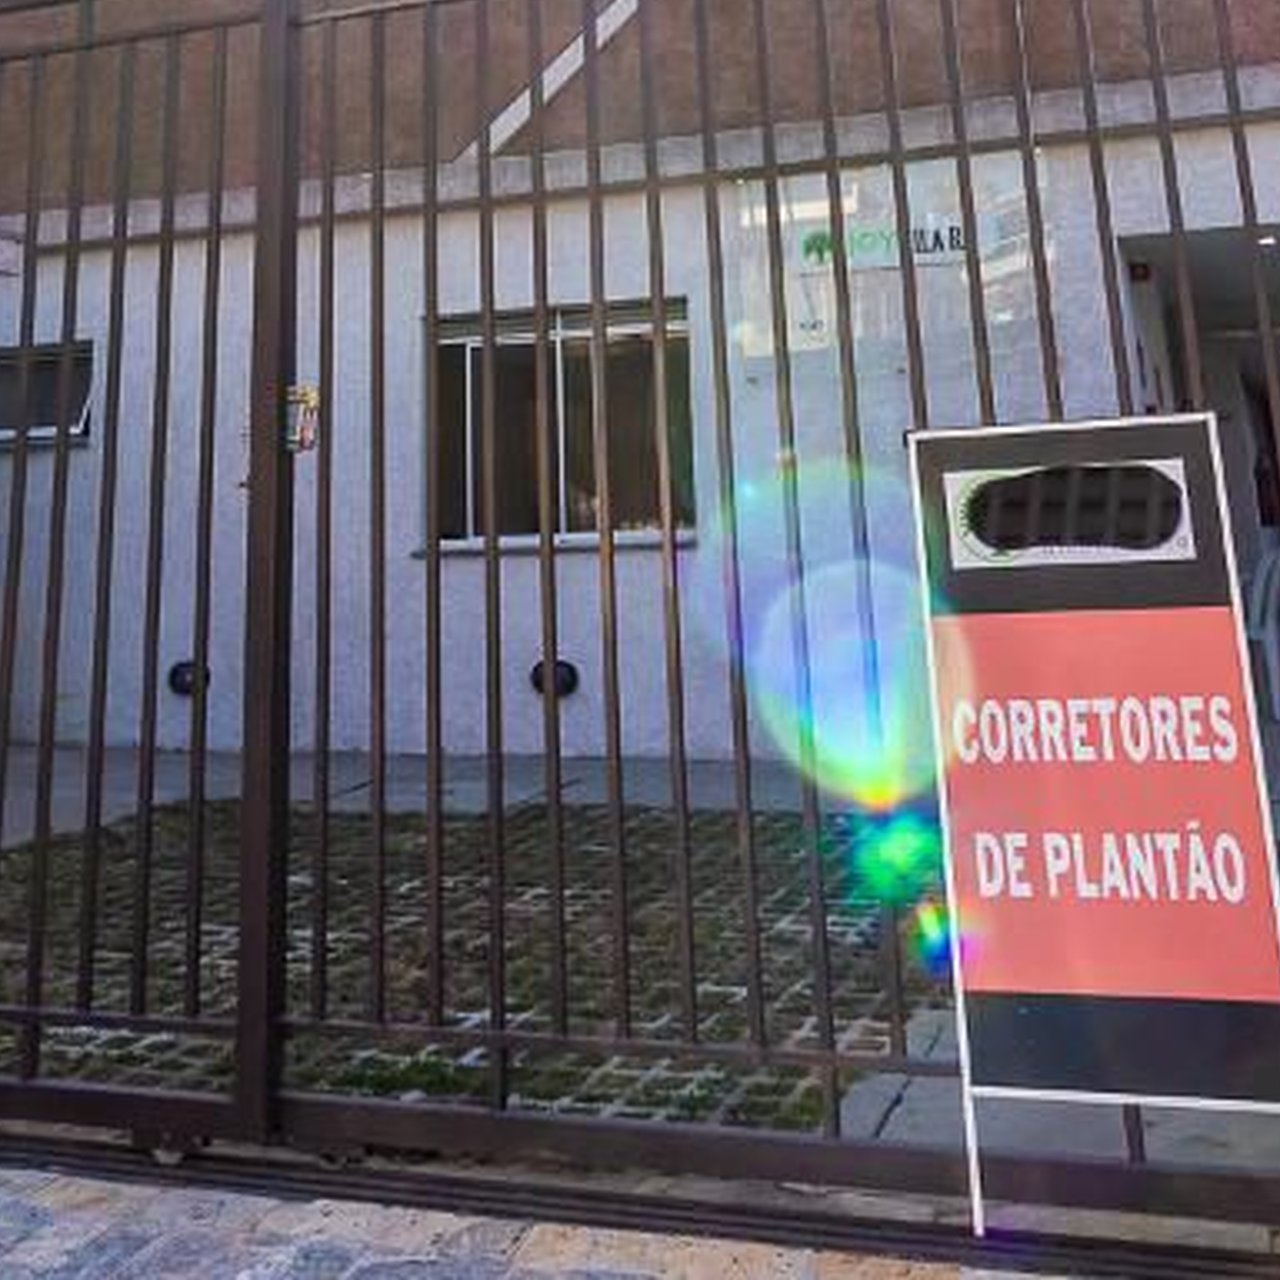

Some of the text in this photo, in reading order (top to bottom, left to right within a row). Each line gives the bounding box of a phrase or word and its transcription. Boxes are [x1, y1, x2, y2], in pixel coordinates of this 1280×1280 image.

[952, 696, 1239, 764] CORRETORES
[975, 819, 1246, 904] DE PLANTÃO
